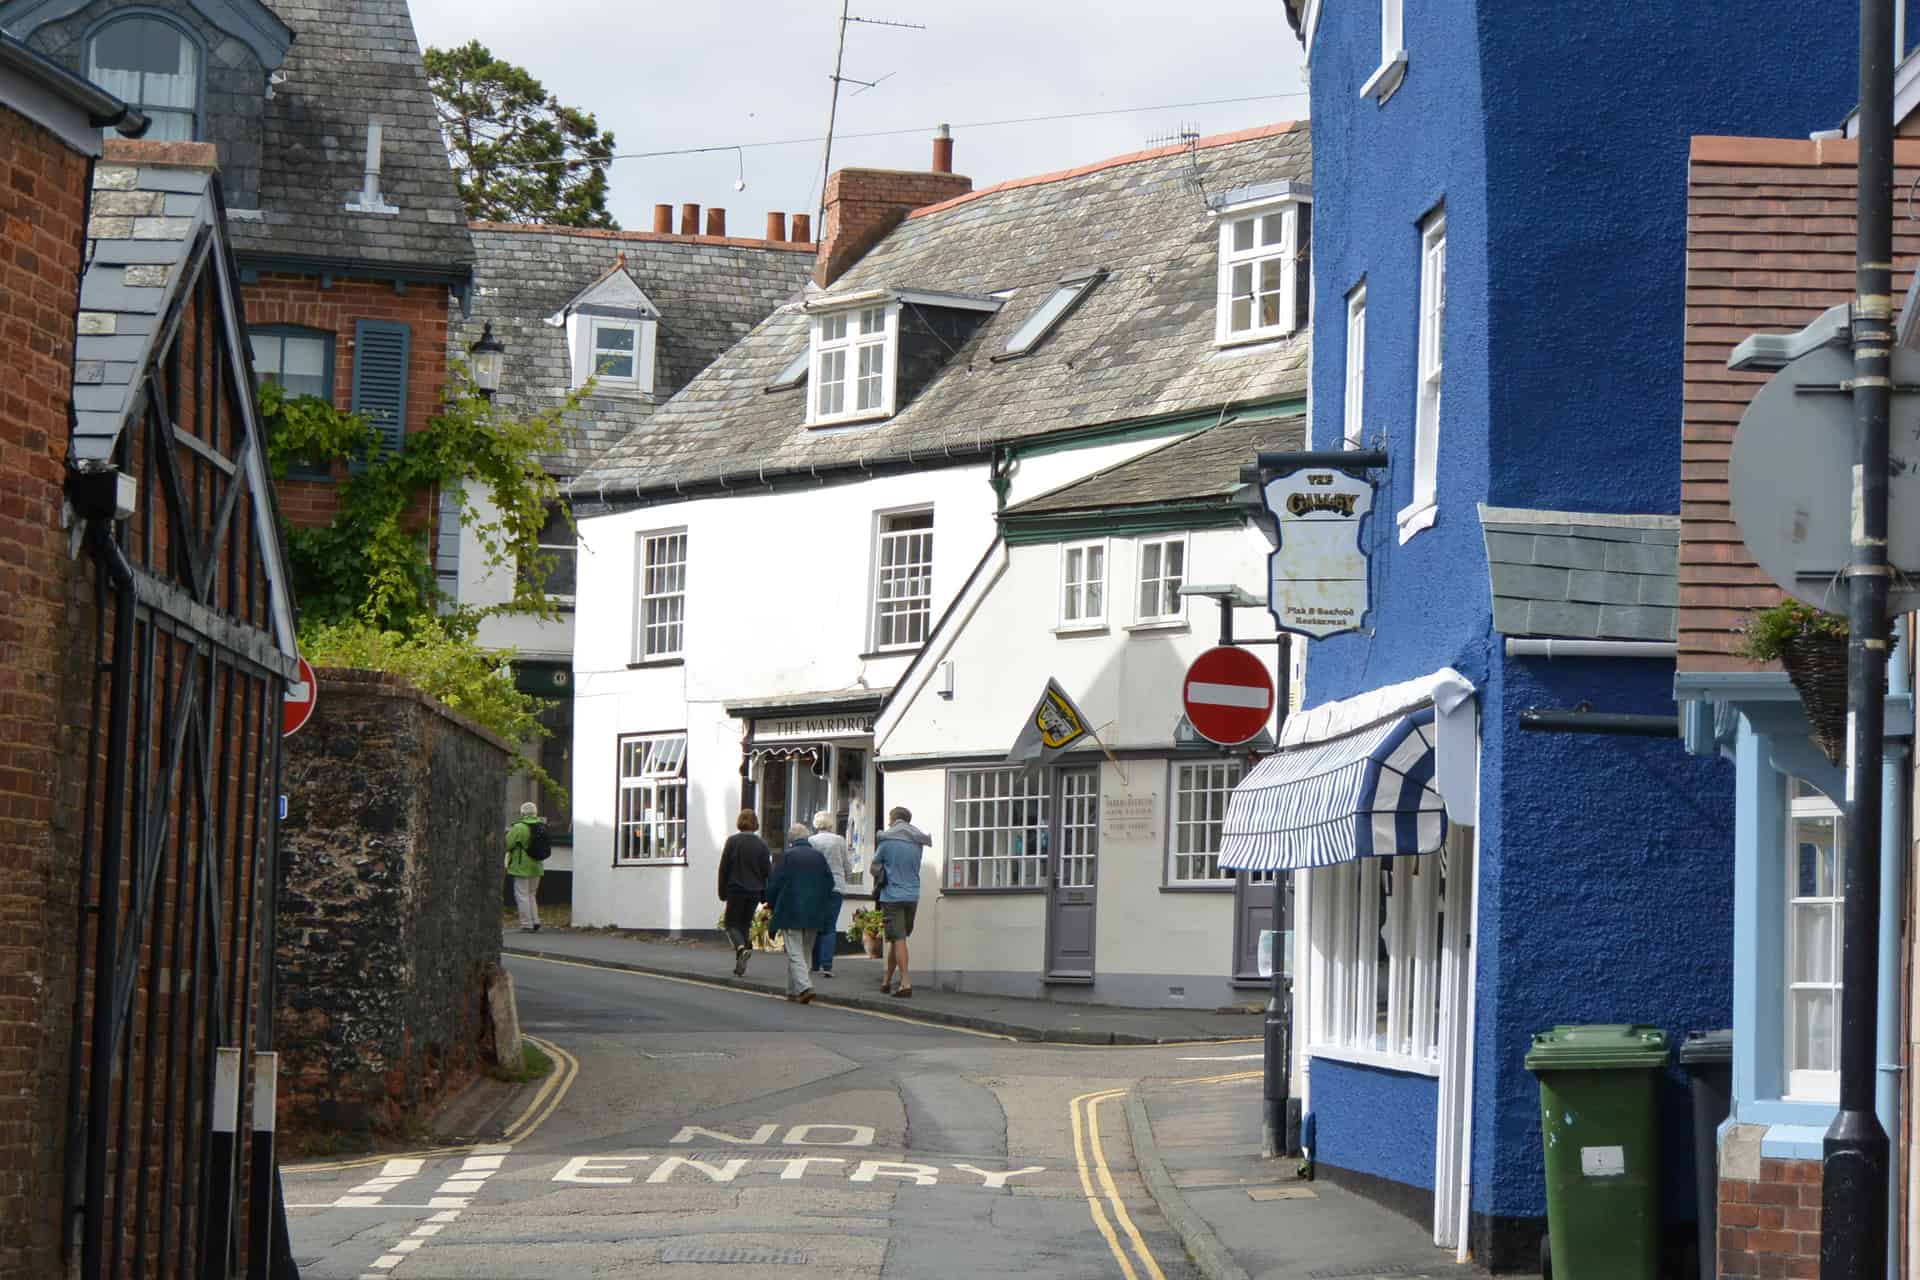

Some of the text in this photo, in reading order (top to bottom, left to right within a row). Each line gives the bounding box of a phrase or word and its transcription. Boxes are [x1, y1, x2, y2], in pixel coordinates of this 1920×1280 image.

[776, 720, 801, 736] THE
[669, 1123, 876, 1146] NO
[552, 1155, 1046, 1188] ENTRY
